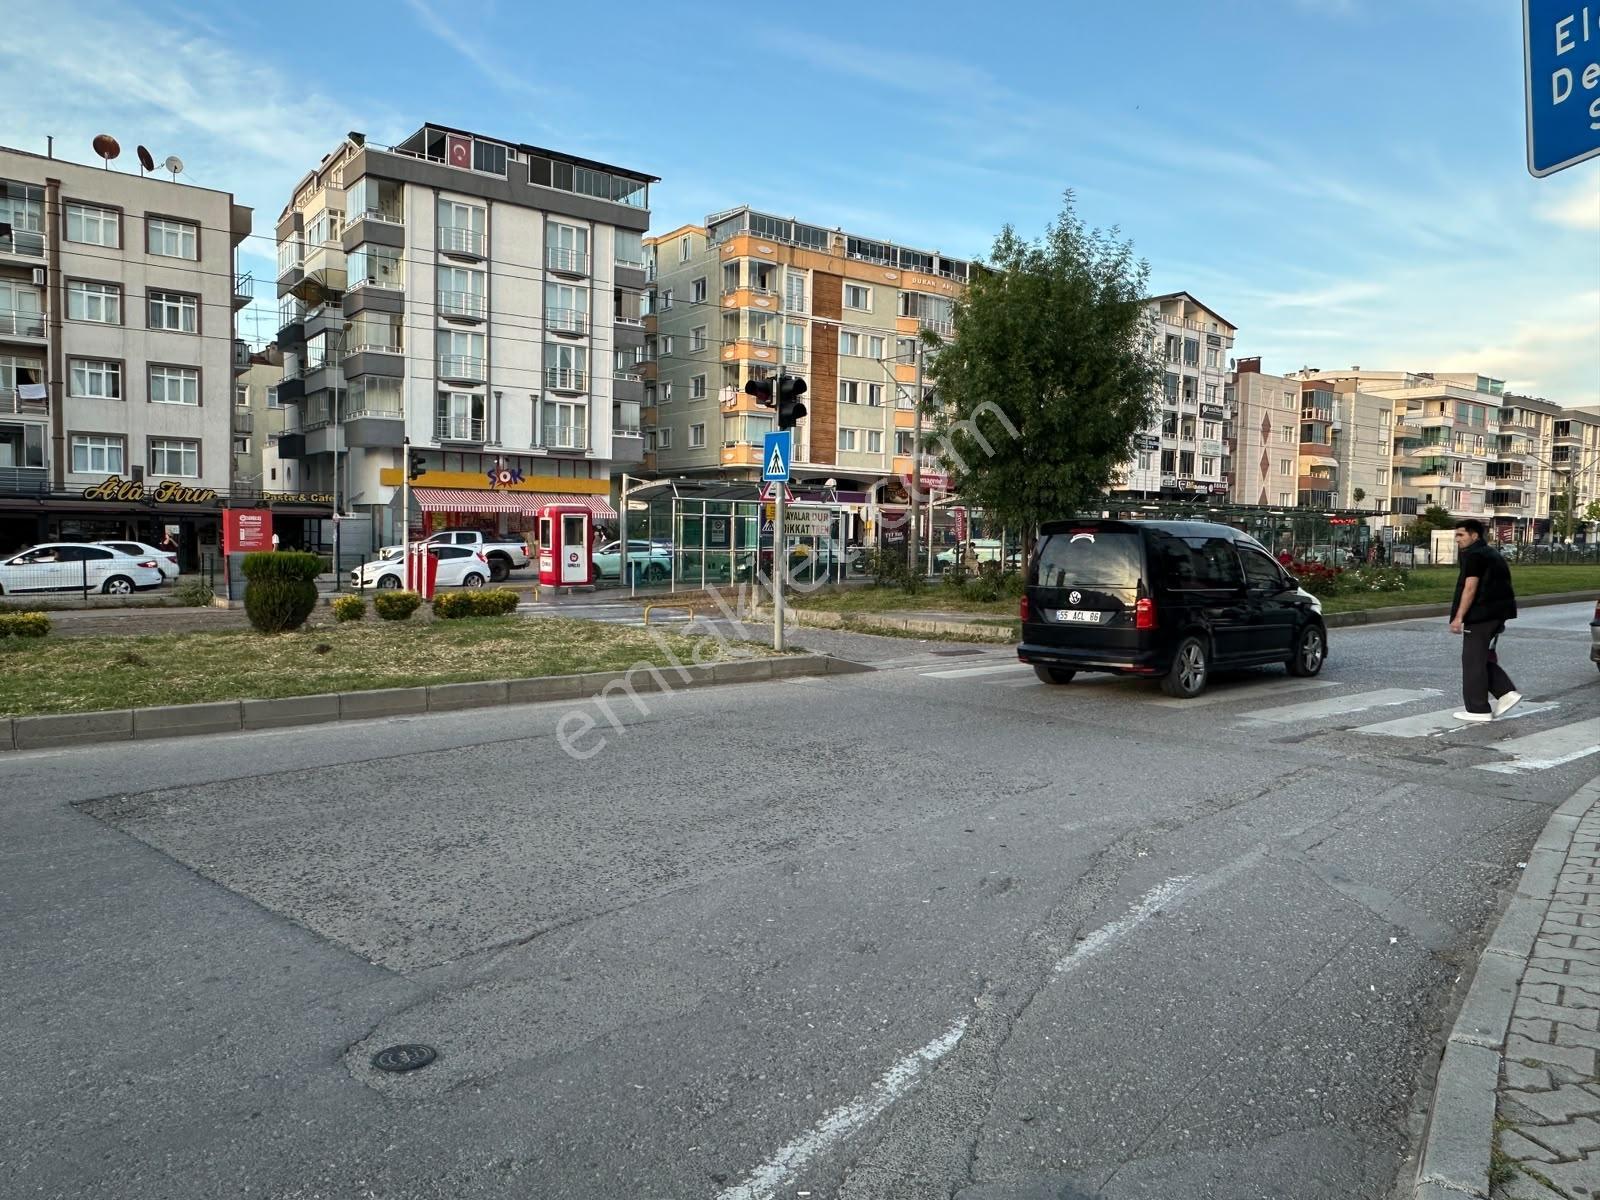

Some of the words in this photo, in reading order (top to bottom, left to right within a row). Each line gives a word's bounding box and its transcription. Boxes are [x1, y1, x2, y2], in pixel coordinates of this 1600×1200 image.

[1556, 7, 1600, 56] El
[262, 492, 296, 501] Pasta
[299, 493, 306, 502] &
[785, 511, 810, 521] AYALAR
[811, 512, 829, 522] DUR
[1060, 611, 1068, 620] 55
[1073, 611, 1085, 620] ACL
